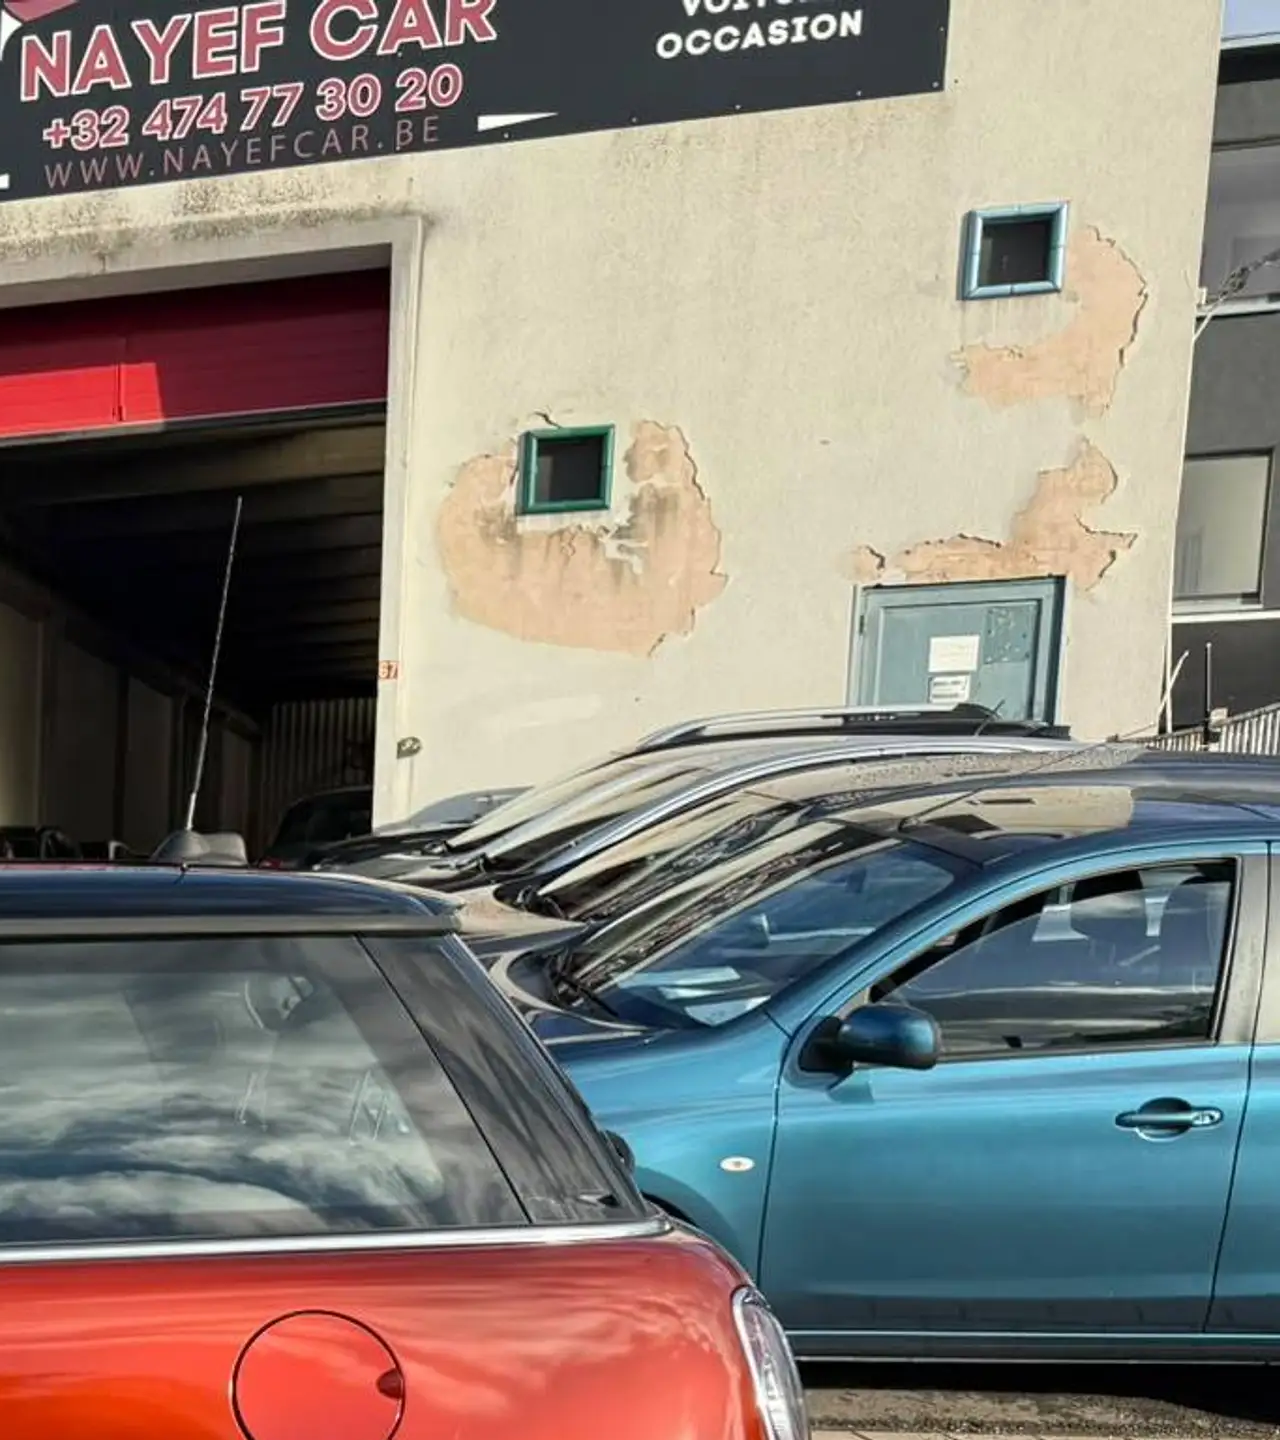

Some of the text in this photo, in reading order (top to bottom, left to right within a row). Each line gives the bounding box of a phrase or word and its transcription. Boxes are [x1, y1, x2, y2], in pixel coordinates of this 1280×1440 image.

[20, 0, 497, 101] NAYEF CAR
[655, 9, 864, 59] OCCASION
[43, 64, 463, 151] +32 474 77 30 20
[44, 116, 440, 190] WWW.NAYEFCAR.BE
